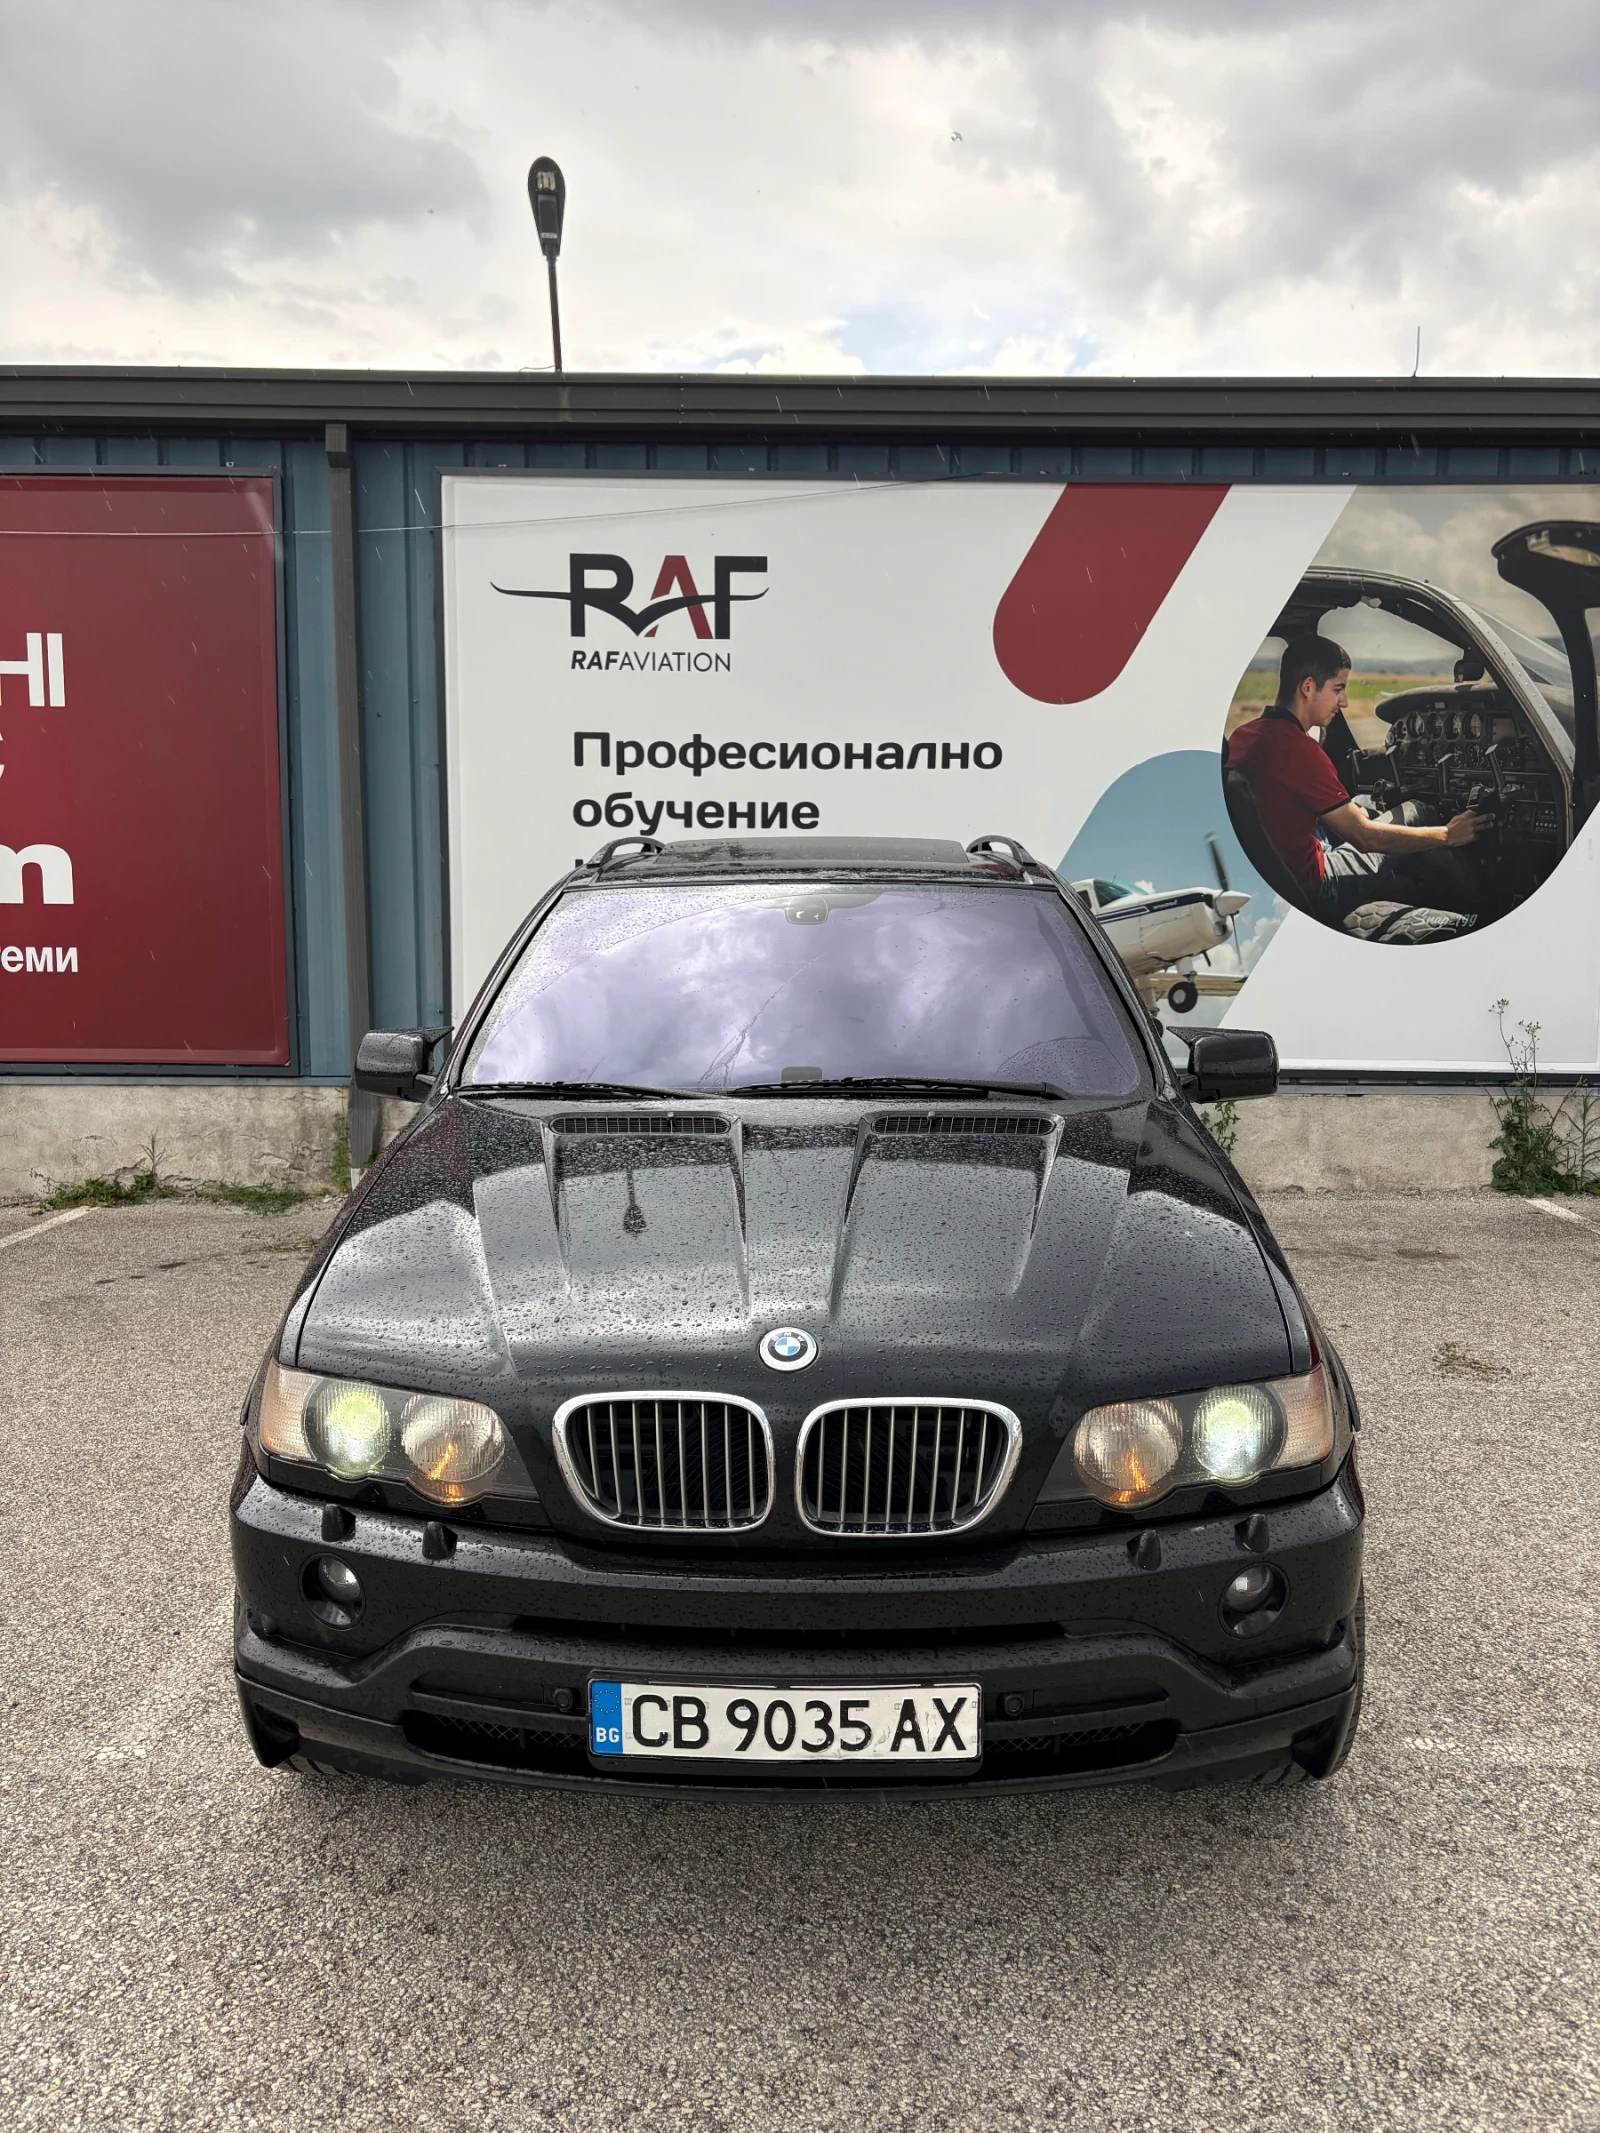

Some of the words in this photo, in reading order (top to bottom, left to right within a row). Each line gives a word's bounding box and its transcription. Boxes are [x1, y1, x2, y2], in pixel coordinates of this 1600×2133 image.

[570, 553, 768, 640] RAF
[571, 650, 731, 672] RAFAVIATION
[573, 731, 1002, 777] Професионално
[572, 792, 820, 835] обучение
[595, 1726, 620, 1744] BG
[632, 1694, 709, 1749] CB
[725, 1699, 872, 1753] 9035
[890, 1697, 968, 1752] AX
